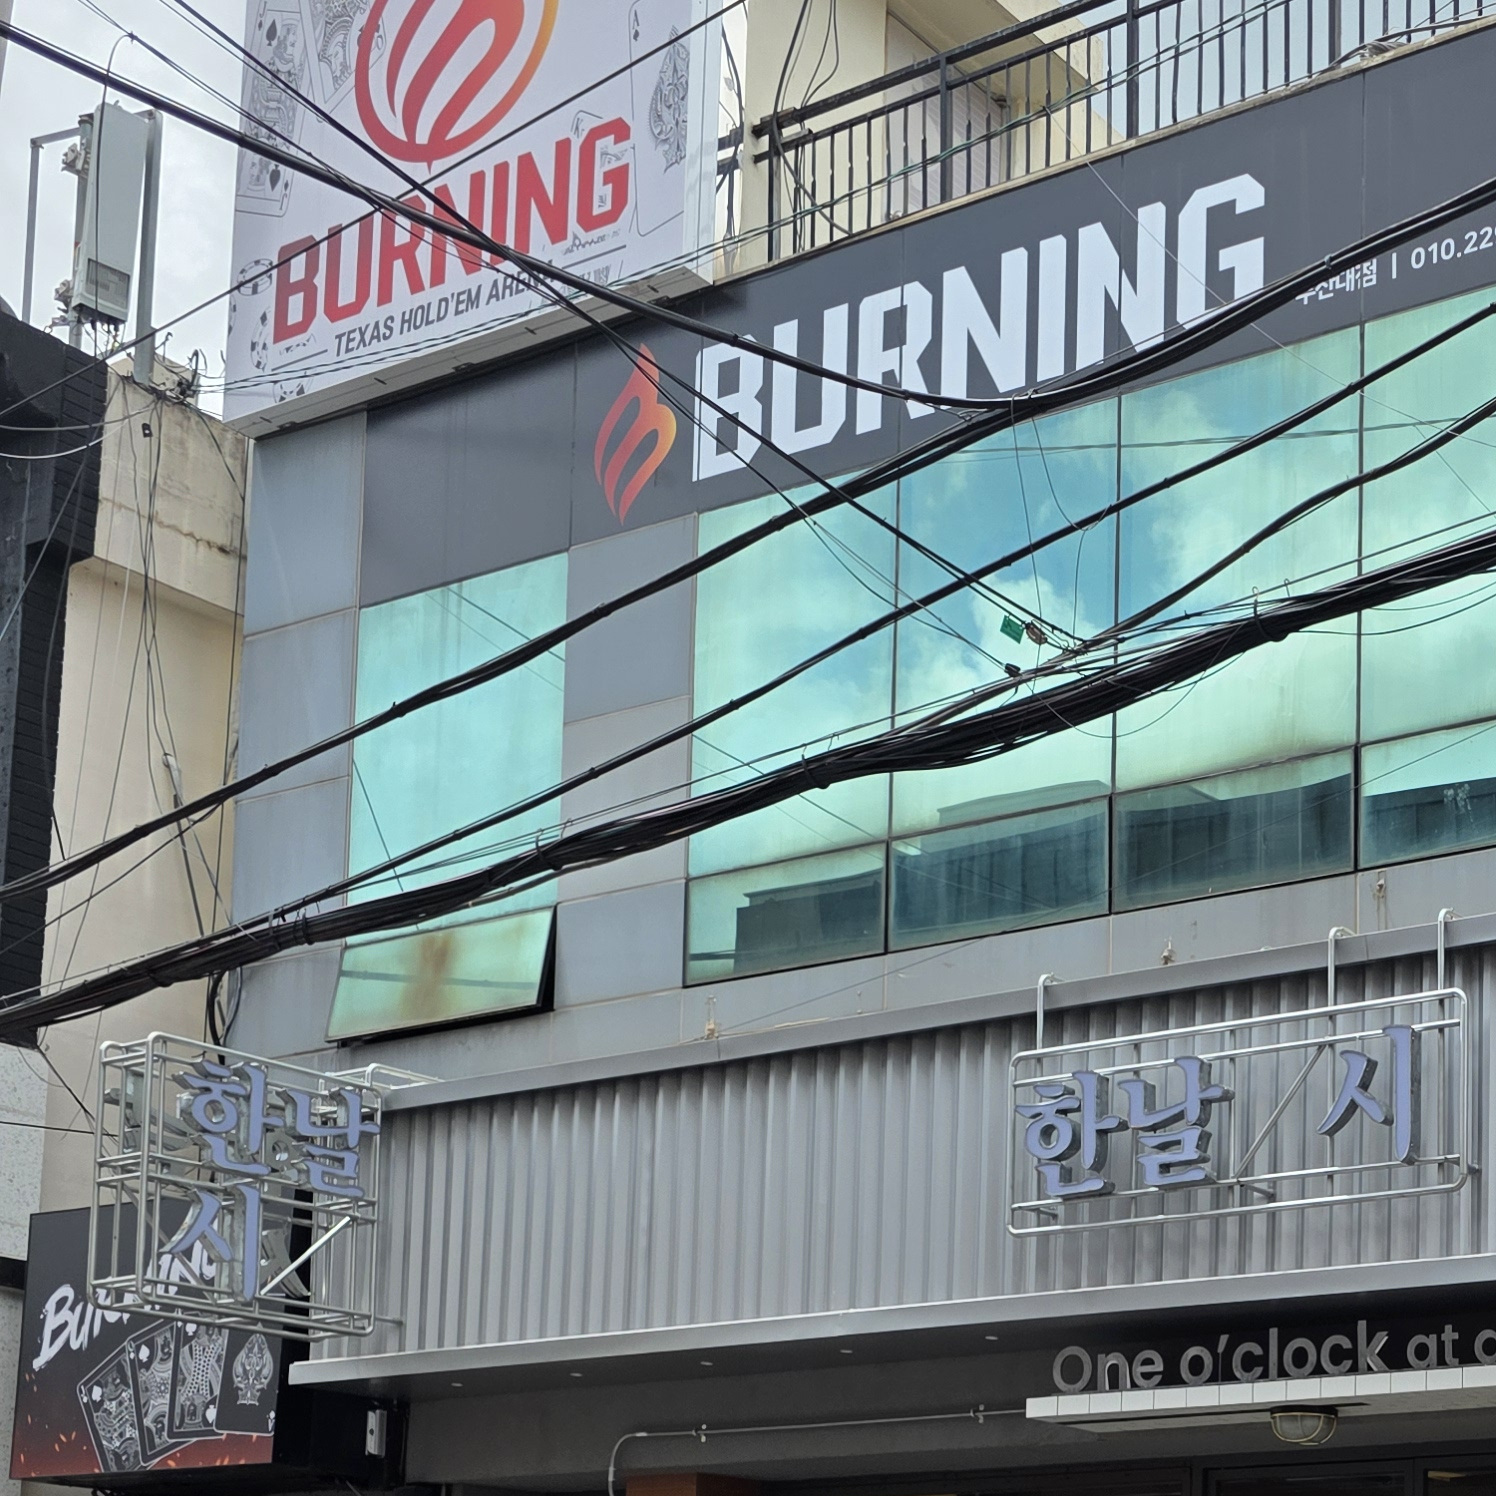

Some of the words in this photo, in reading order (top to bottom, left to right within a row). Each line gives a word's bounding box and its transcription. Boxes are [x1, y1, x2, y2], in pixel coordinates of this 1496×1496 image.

[272, 117, 631, 345] BURNING
[334, 314, 396, 358] TEXAS
[692, 172, 1266, 482] BURNING
[1015, 1055, 1235, 1200] 한날
[1315, 1024, 1421, 1165] 시
[160, 1183, 262, 1301] 시
[1052, 1345, 1164, 1394] One
[1180, 1319, 1393, 1386] o'clock
[1407, 1323, 1460, 1370] at
